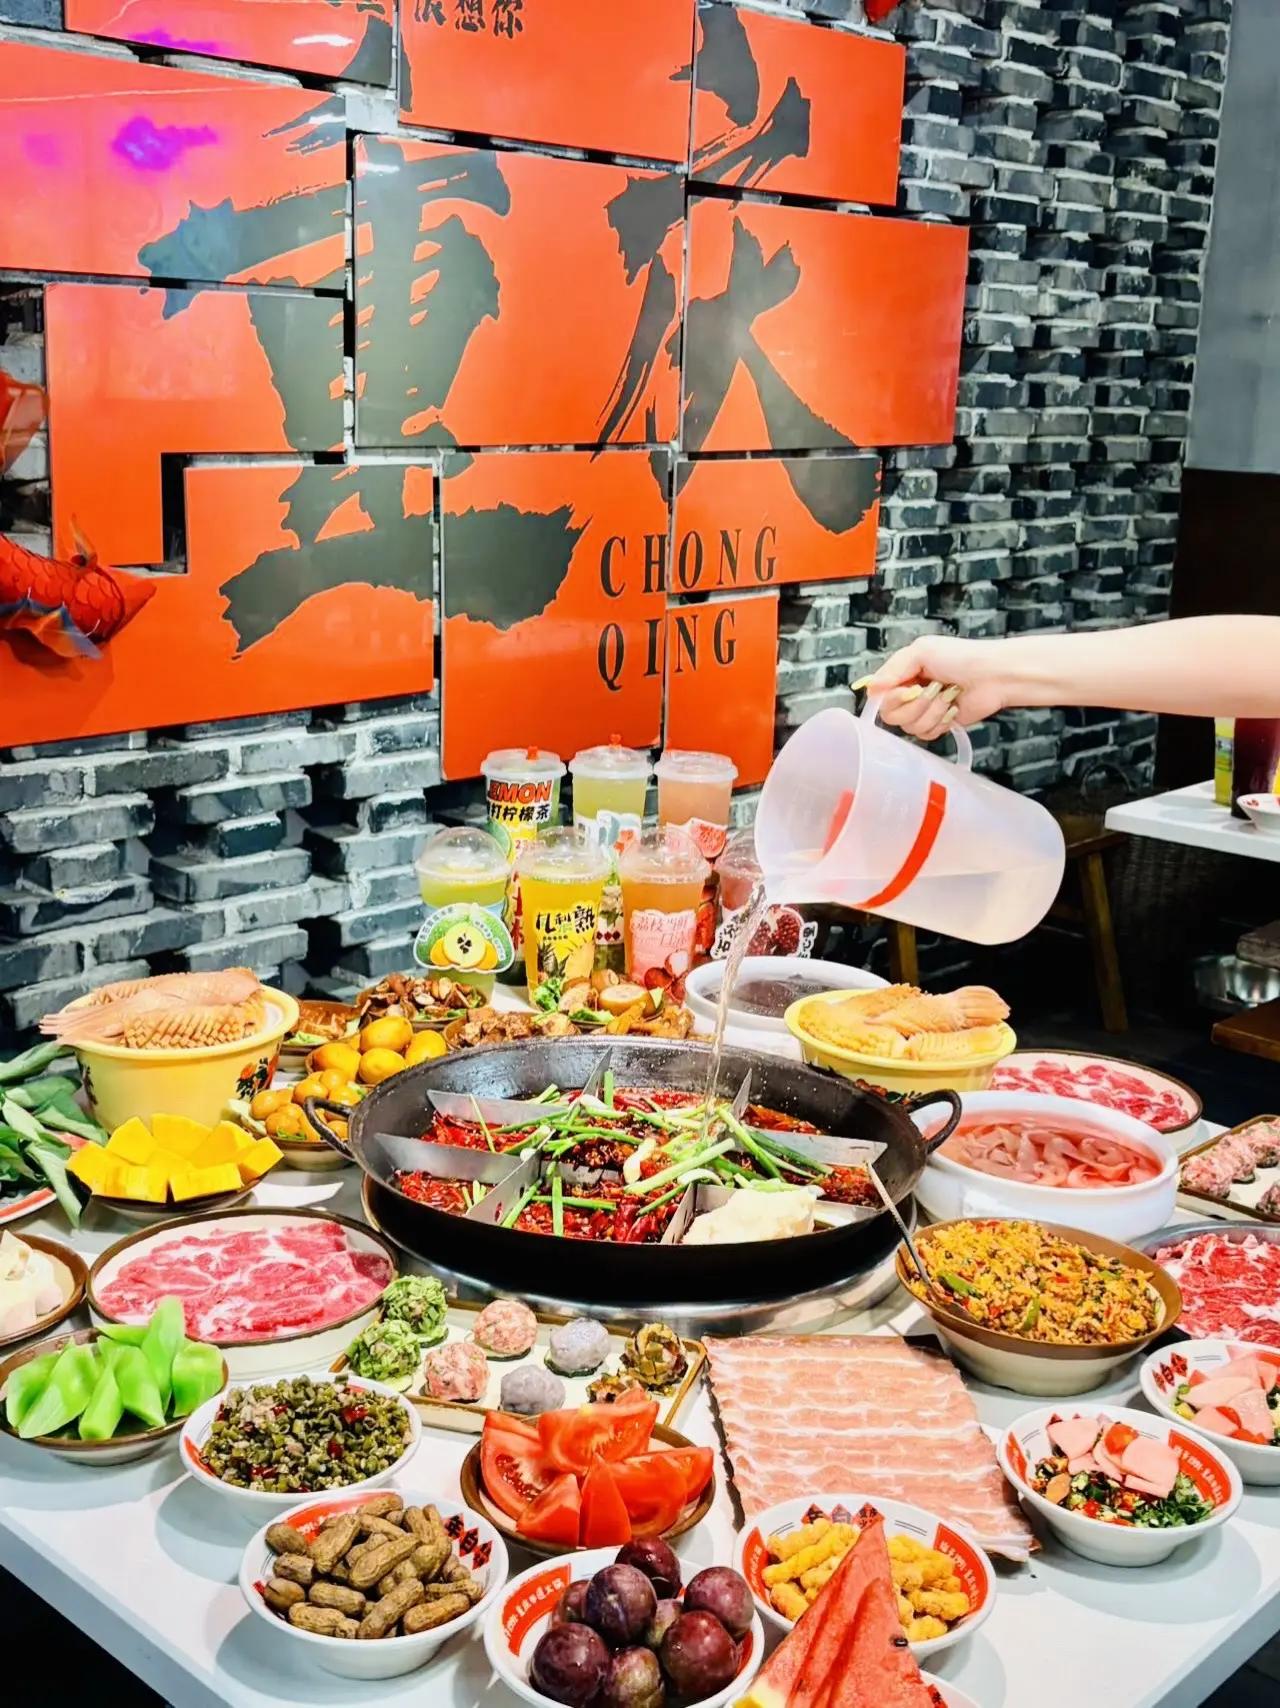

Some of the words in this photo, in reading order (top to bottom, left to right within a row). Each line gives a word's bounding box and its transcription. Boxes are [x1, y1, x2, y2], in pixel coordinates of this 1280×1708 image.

[600, 526, 777, 598] CHONG
[597, 608, 737, 692] QING
[487, 779, 553, 804] EMON
